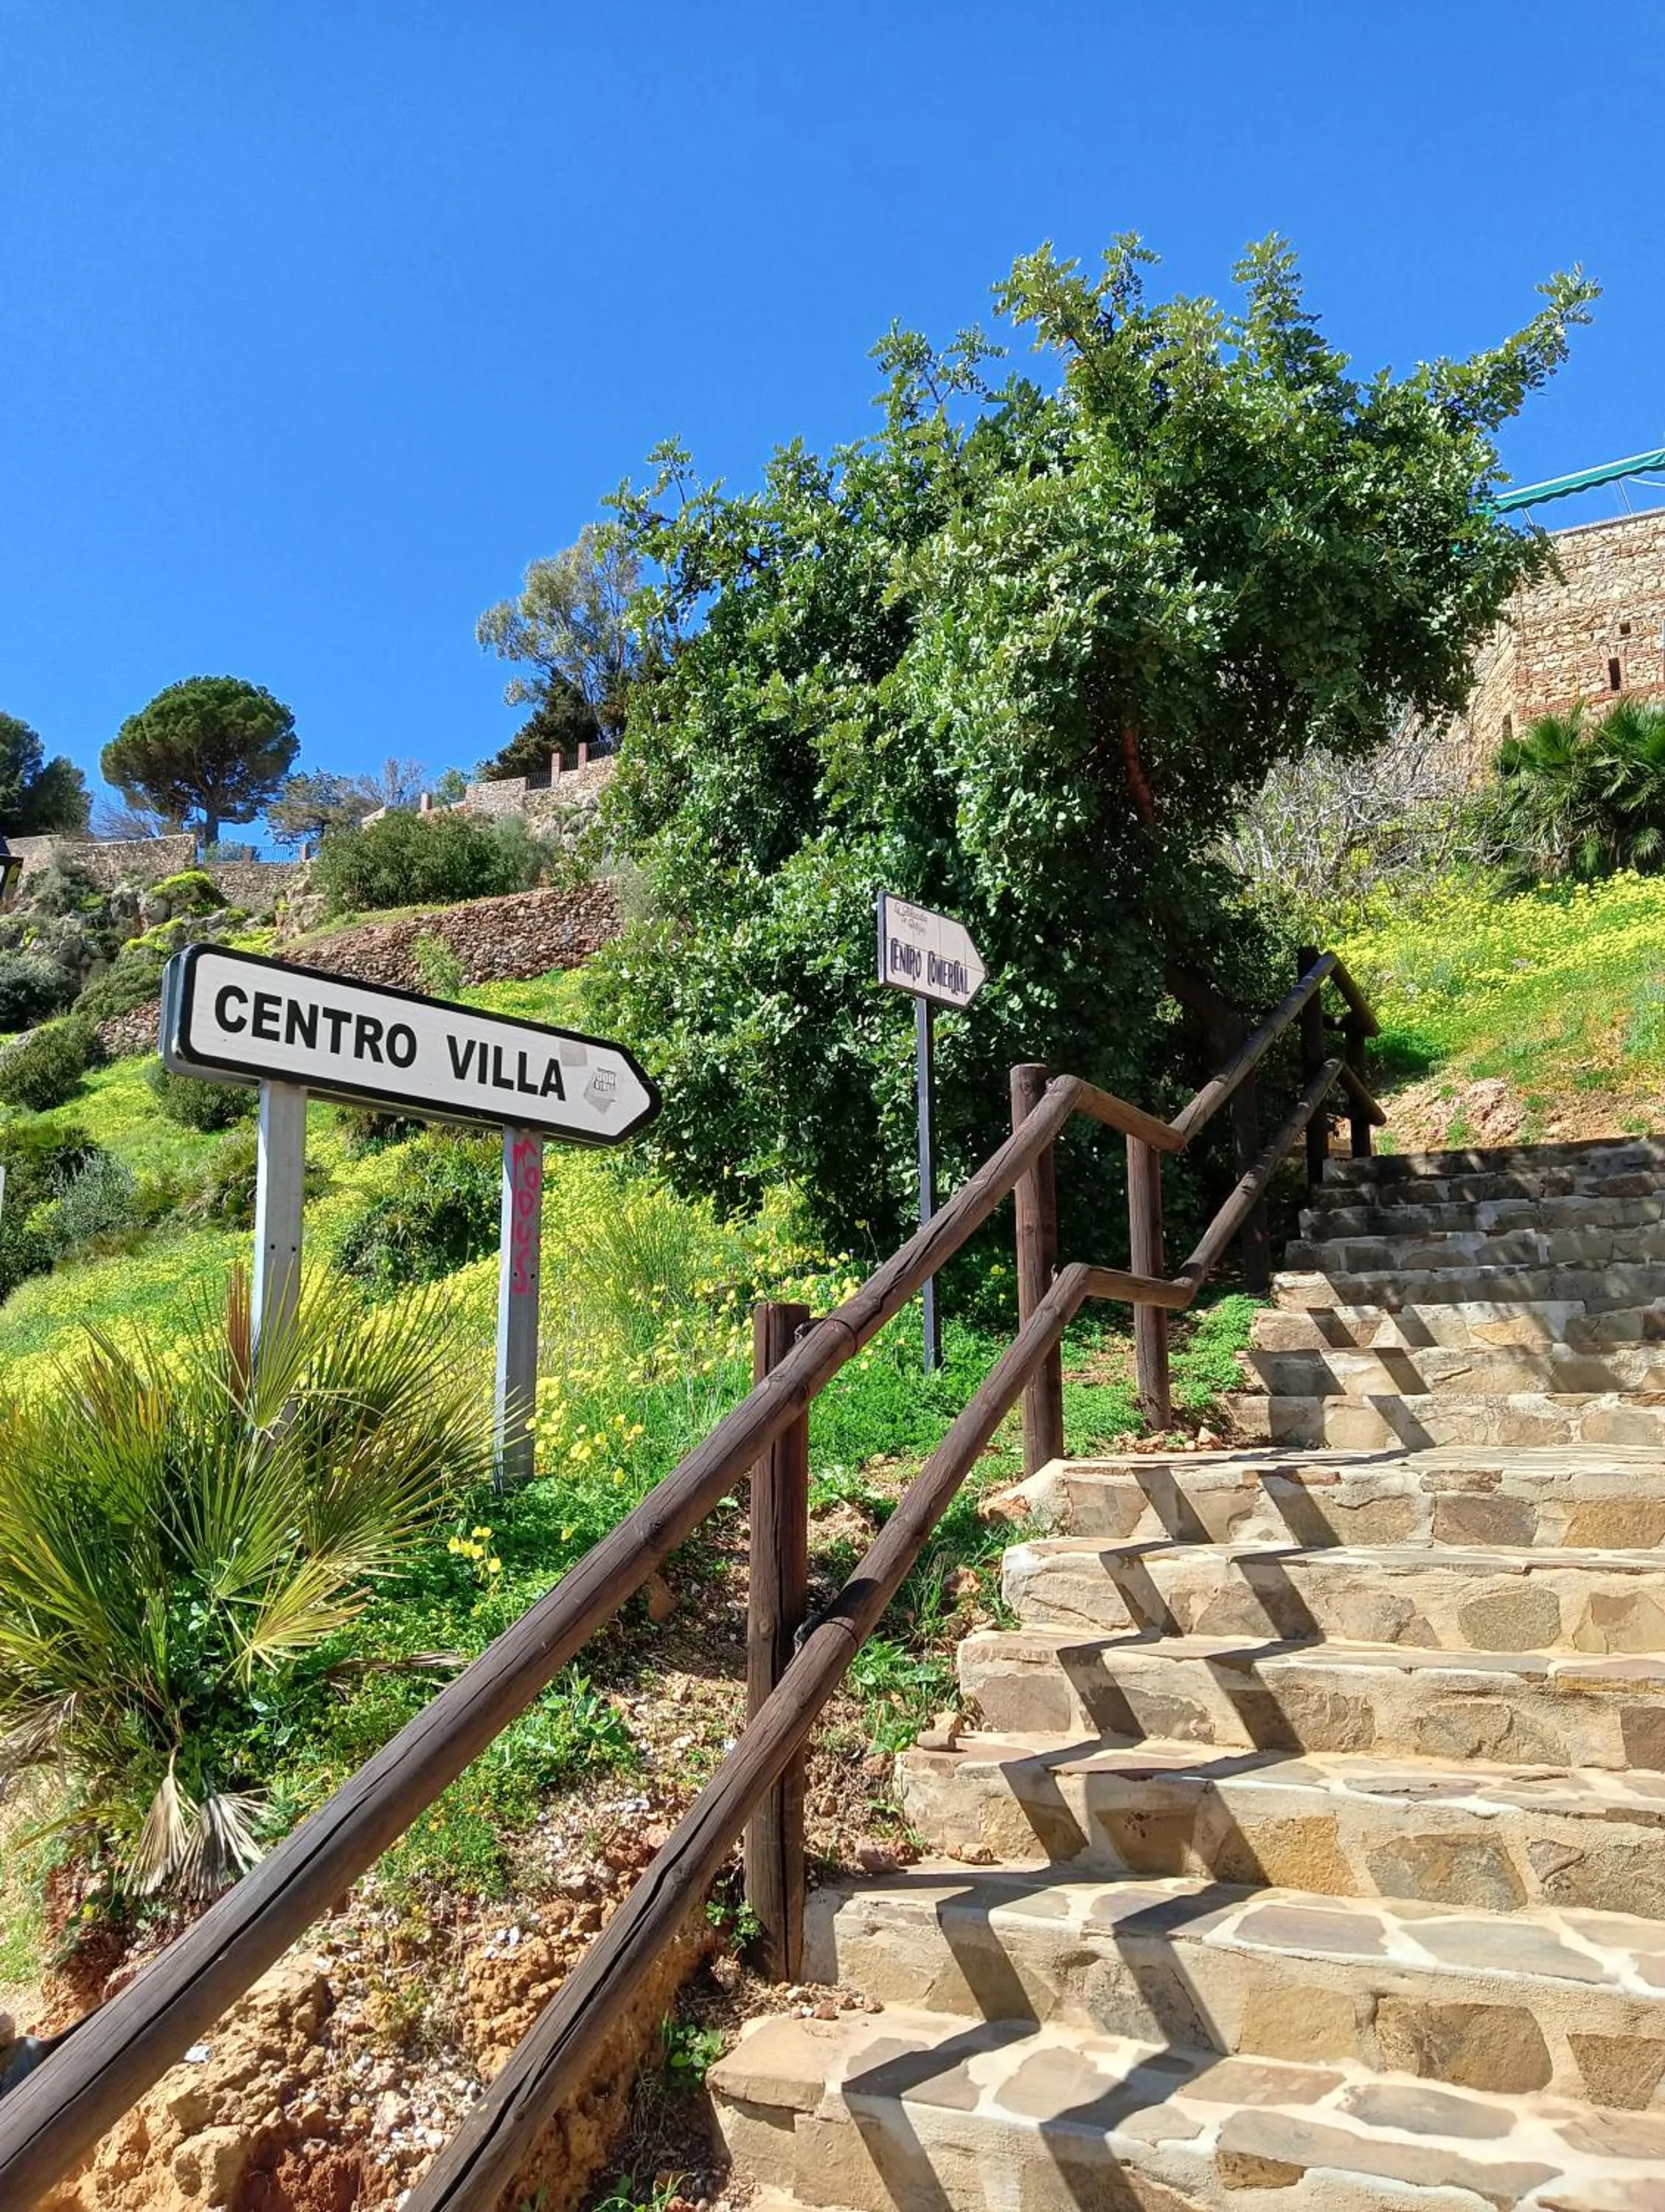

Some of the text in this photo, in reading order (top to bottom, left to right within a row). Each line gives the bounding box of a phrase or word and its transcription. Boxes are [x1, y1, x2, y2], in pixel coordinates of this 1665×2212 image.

[890, 938, 921, 981] CENTRO
[215, 985, 566, 1102] CENTRO VILLA
